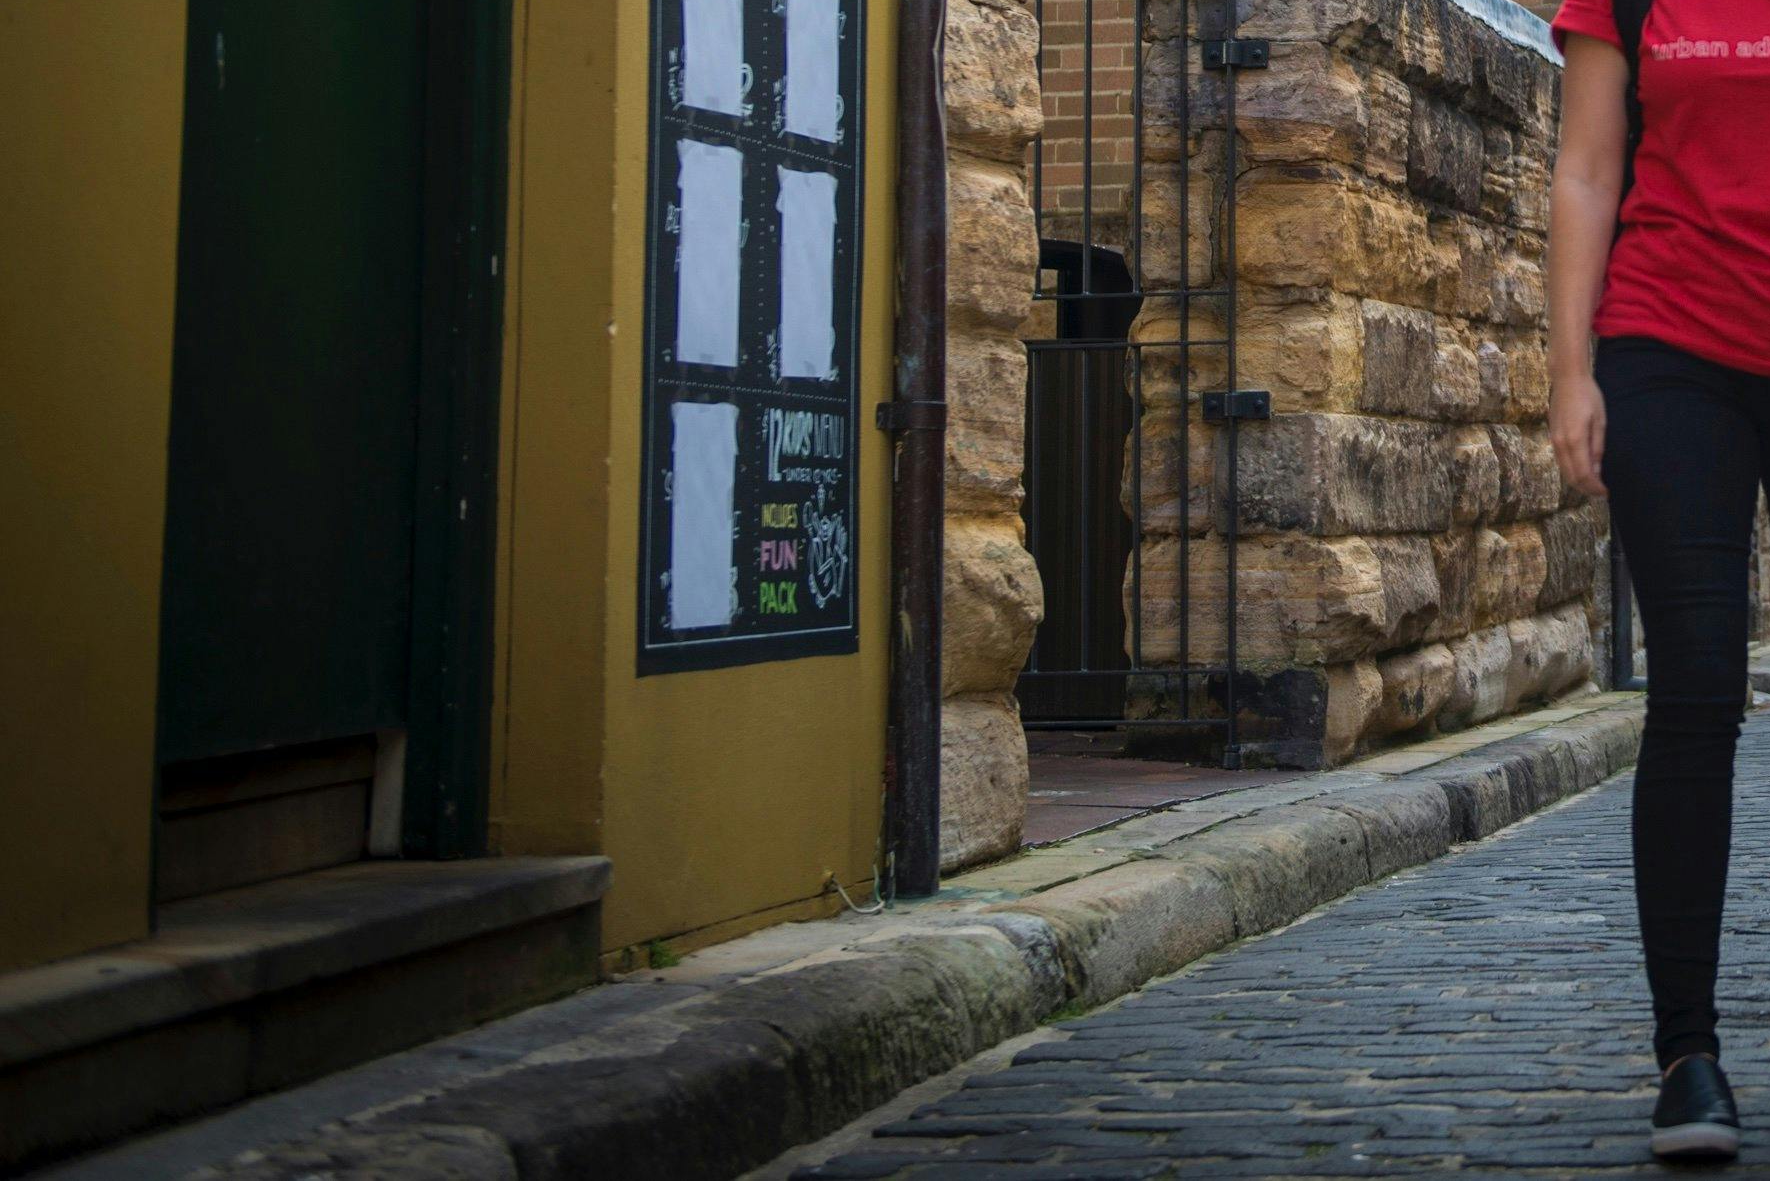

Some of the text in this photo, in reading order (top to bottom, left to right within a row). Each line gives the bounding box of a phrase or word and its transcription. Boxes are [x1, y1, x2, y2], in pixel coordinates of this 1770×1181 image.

[1652, 36, 1730, 61] urban
[760, 539, 798, 571] FUN
[760, 581, 799, 614] PACK
